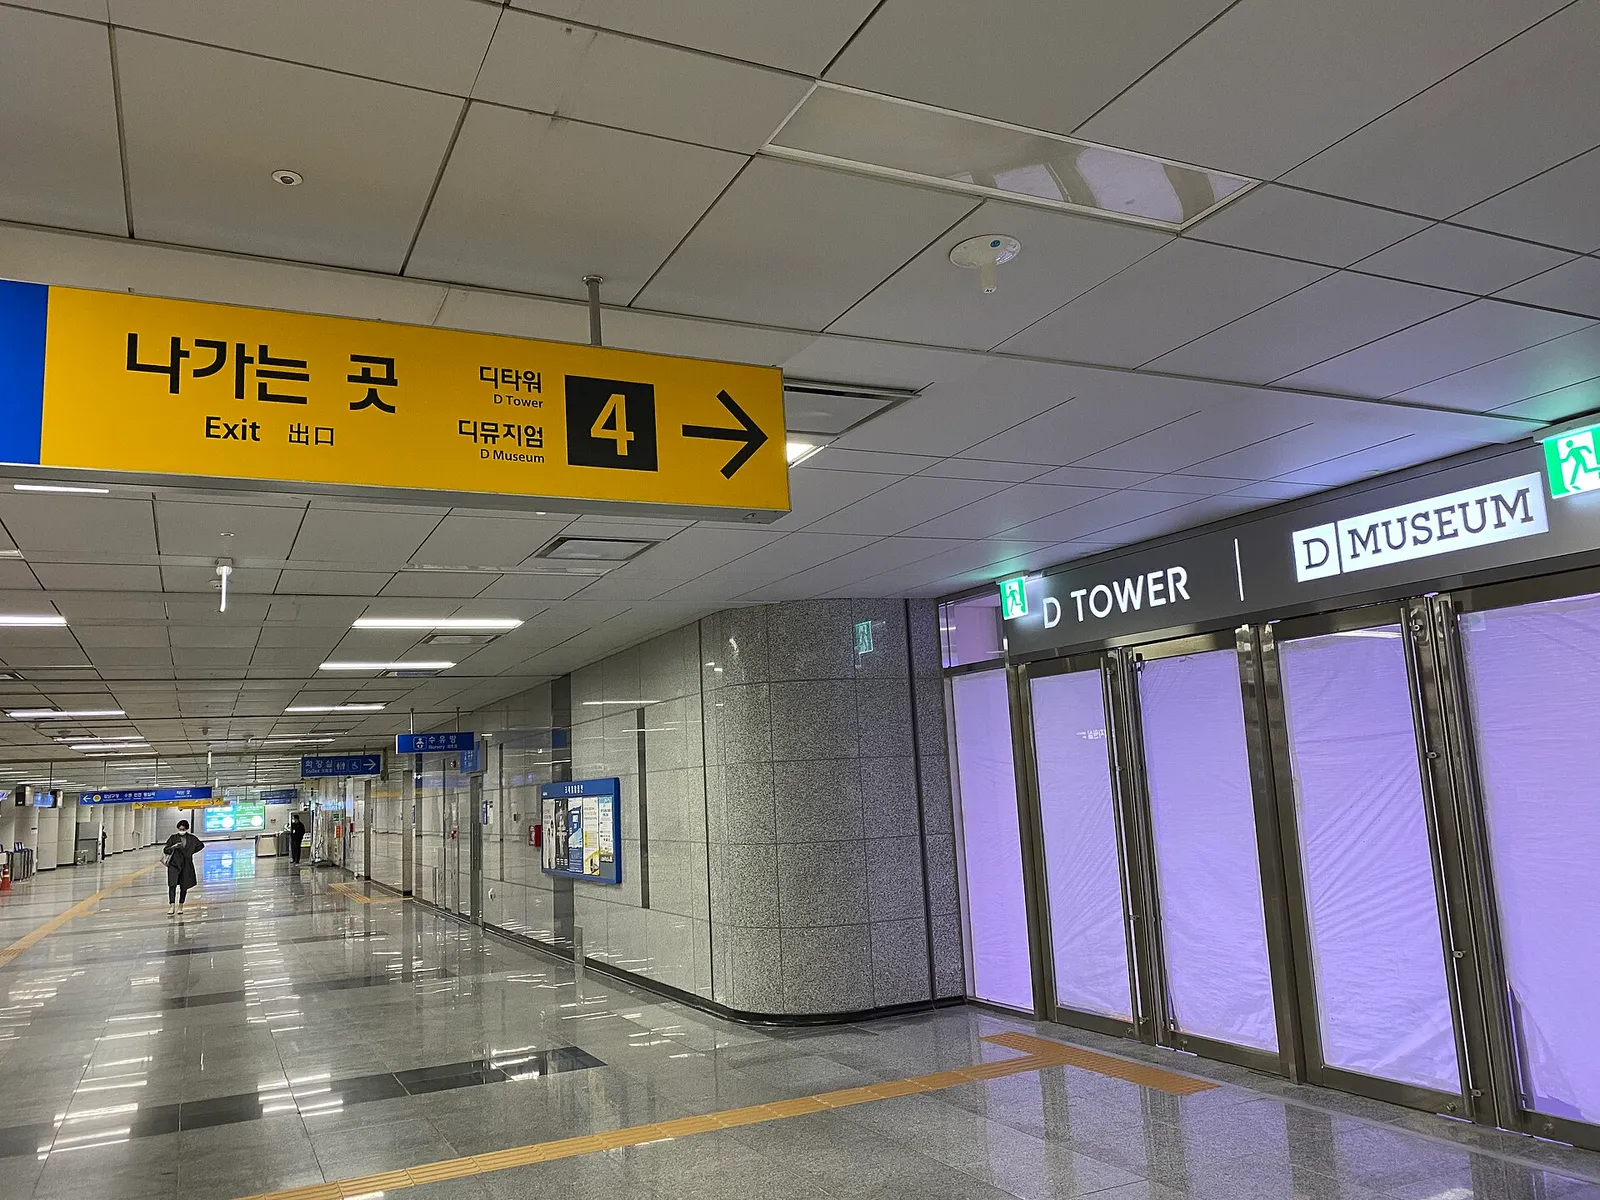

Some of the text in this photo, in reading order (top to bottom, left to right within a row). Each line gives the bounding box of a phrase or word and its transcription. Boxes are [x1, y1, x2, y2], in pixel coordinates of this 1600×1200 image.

[126, 333, 398, 413] 나가는 곳
[479, 366, 542, 394] 디타워
[493, 394, 543, 408] D Tower
[205, 416, 260, 442] Exit
[288, 422, 335, 446] 出口
[458, 419, 544, 449] 디뮤지엄
[590, 393, 635, 456] 4
[480, 449, 545, 463] D Museum
[1303, 487, 1535, 570] D MUSEUM
[1042, 566, 1191, 629] D TOWER
